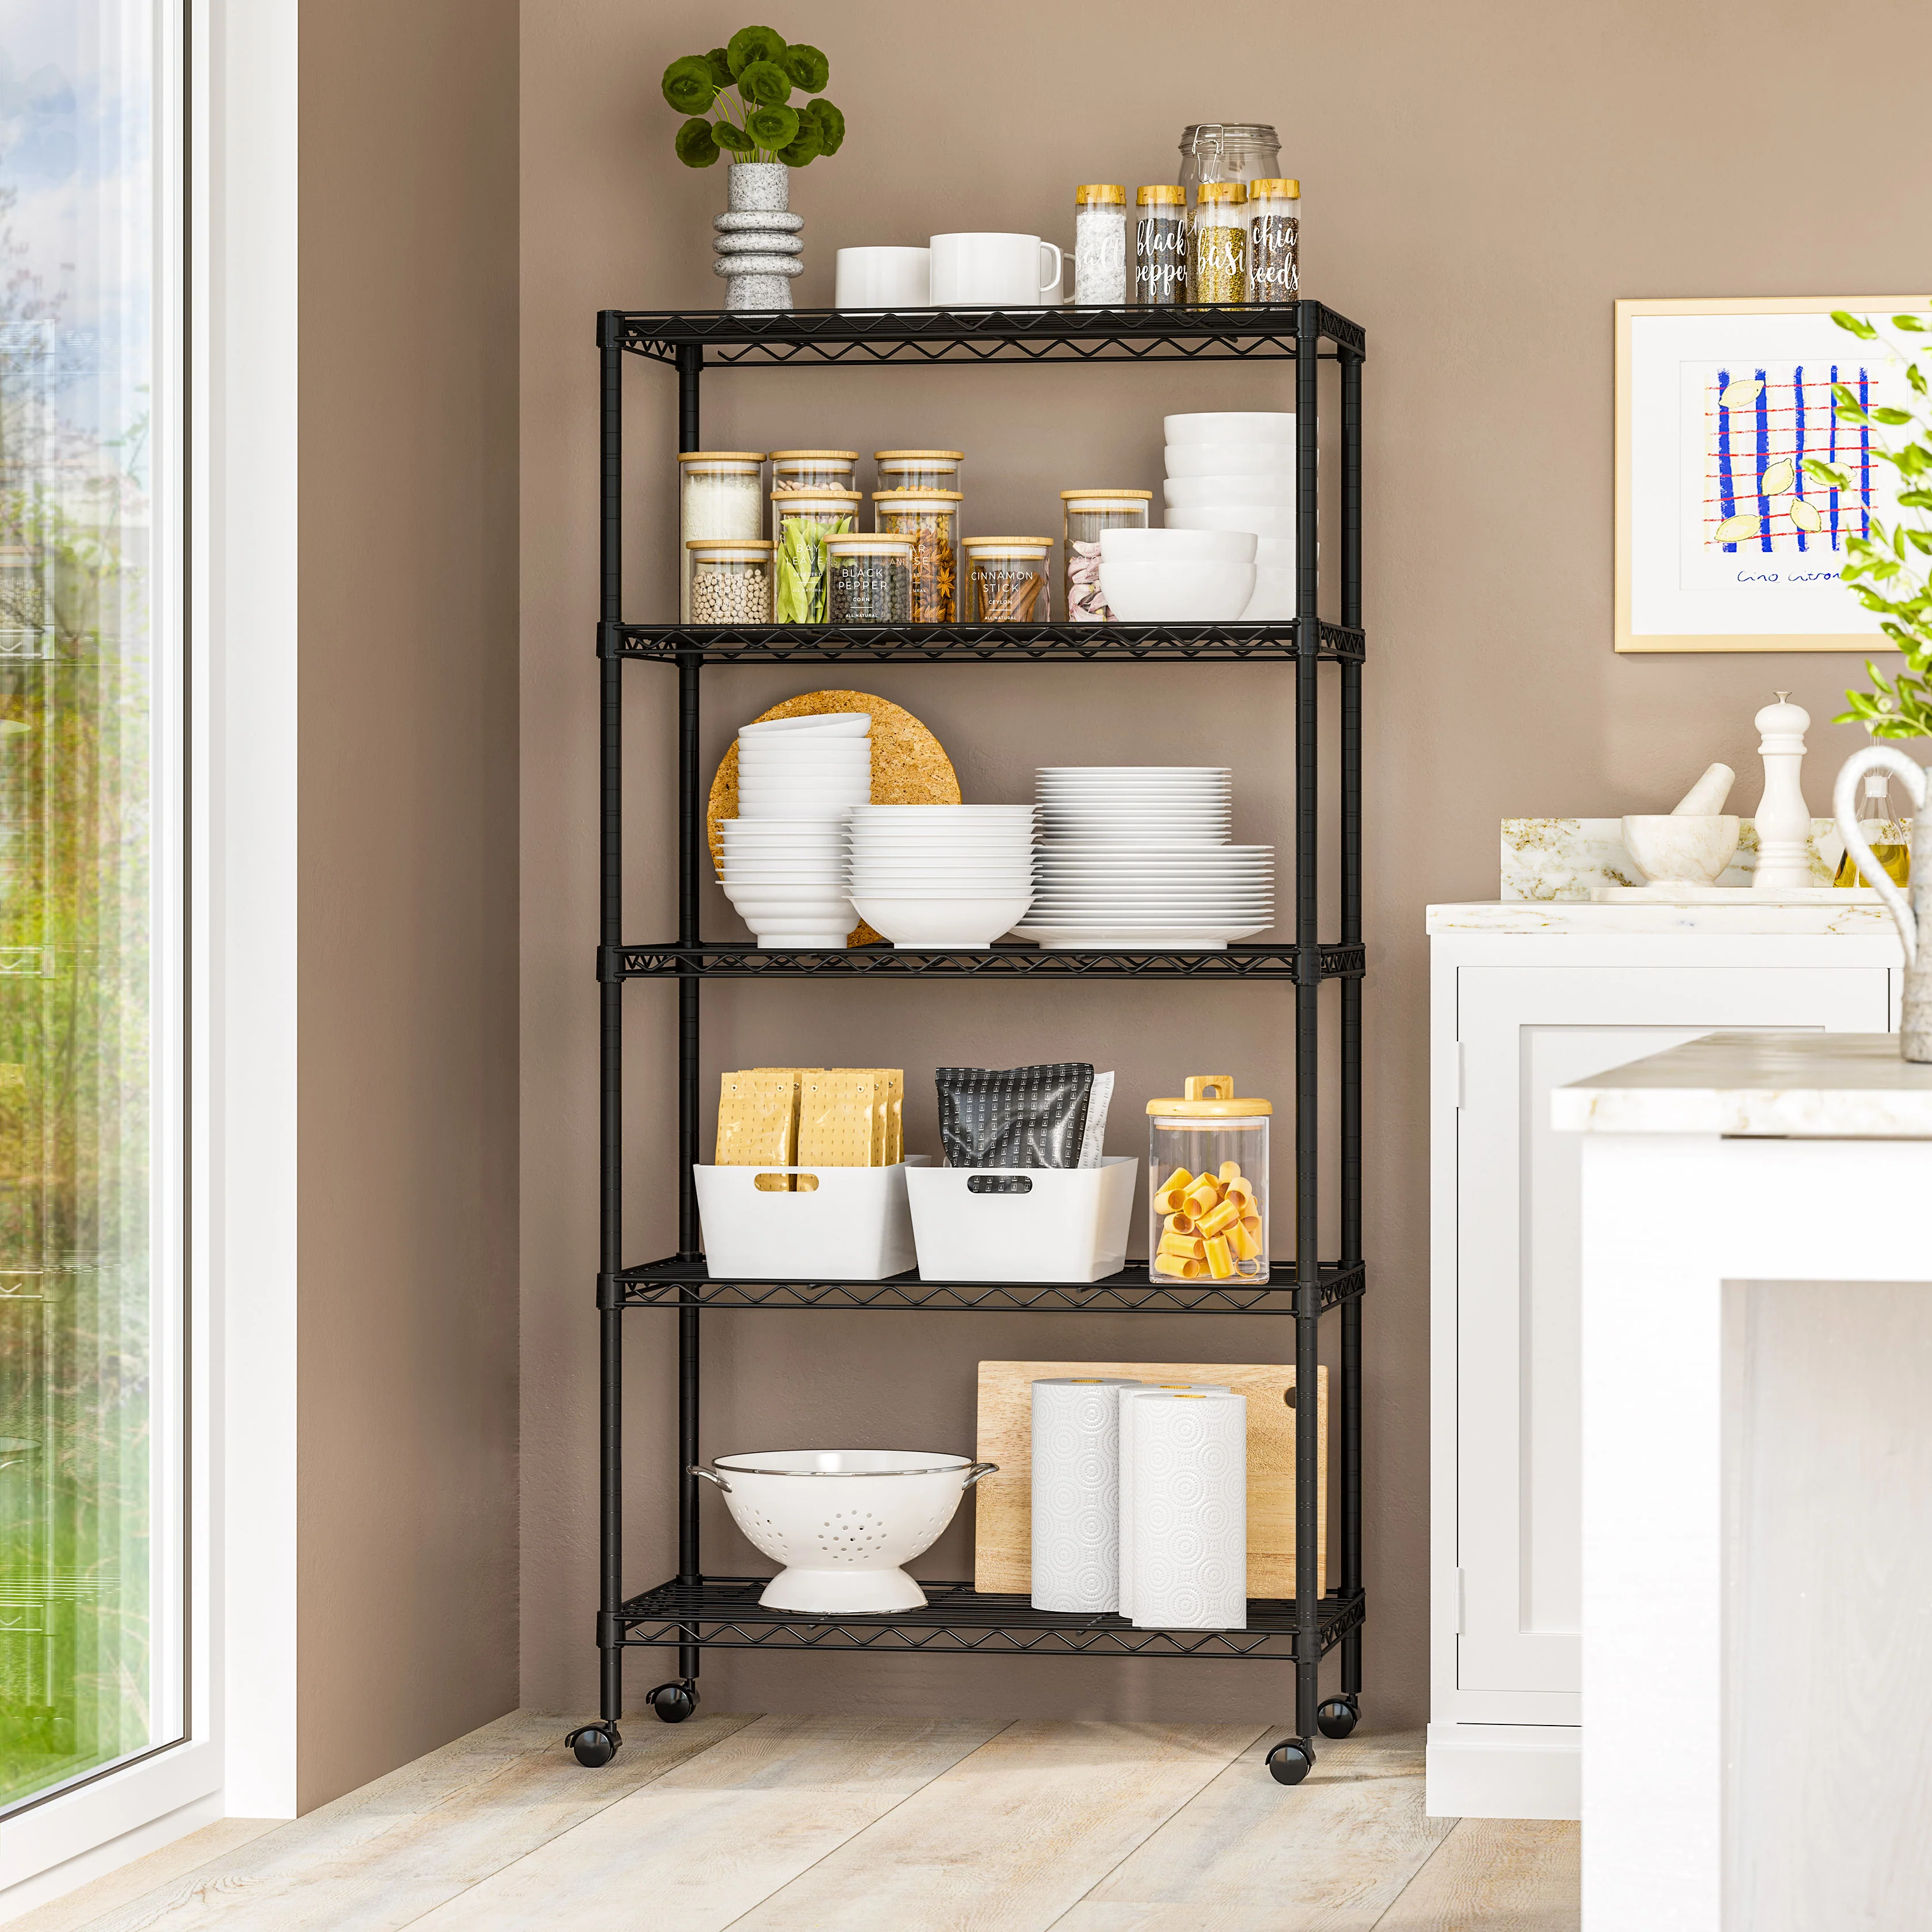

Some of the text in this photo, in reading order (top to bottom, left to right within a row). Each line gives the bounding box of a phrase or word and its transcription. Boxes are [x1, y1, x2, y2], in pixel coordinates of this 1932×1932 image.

[1253, 212, 1298, 252] chia
[1137, 218, 1186, 256] black
[1197, 228, 1247, 276] basi
[1250, 251, 1301, 291] seeds
[1136, 263, 1188, 297] pepper
[796, 544, 821, 553] BAY
[1076, 555, 1099, 564] CLO
[842, 569, 883, 577] BLACK
[971, 572, 1033, 581] CINNAMON
[1788, 570, 1842, 582] citron
[703, 574, 743, 583] WHITE
[838, 581, 887, 590] PEPPER
[983, 584, 1019, 593] STICK
[700, 586, 748, 595] PEPPER
